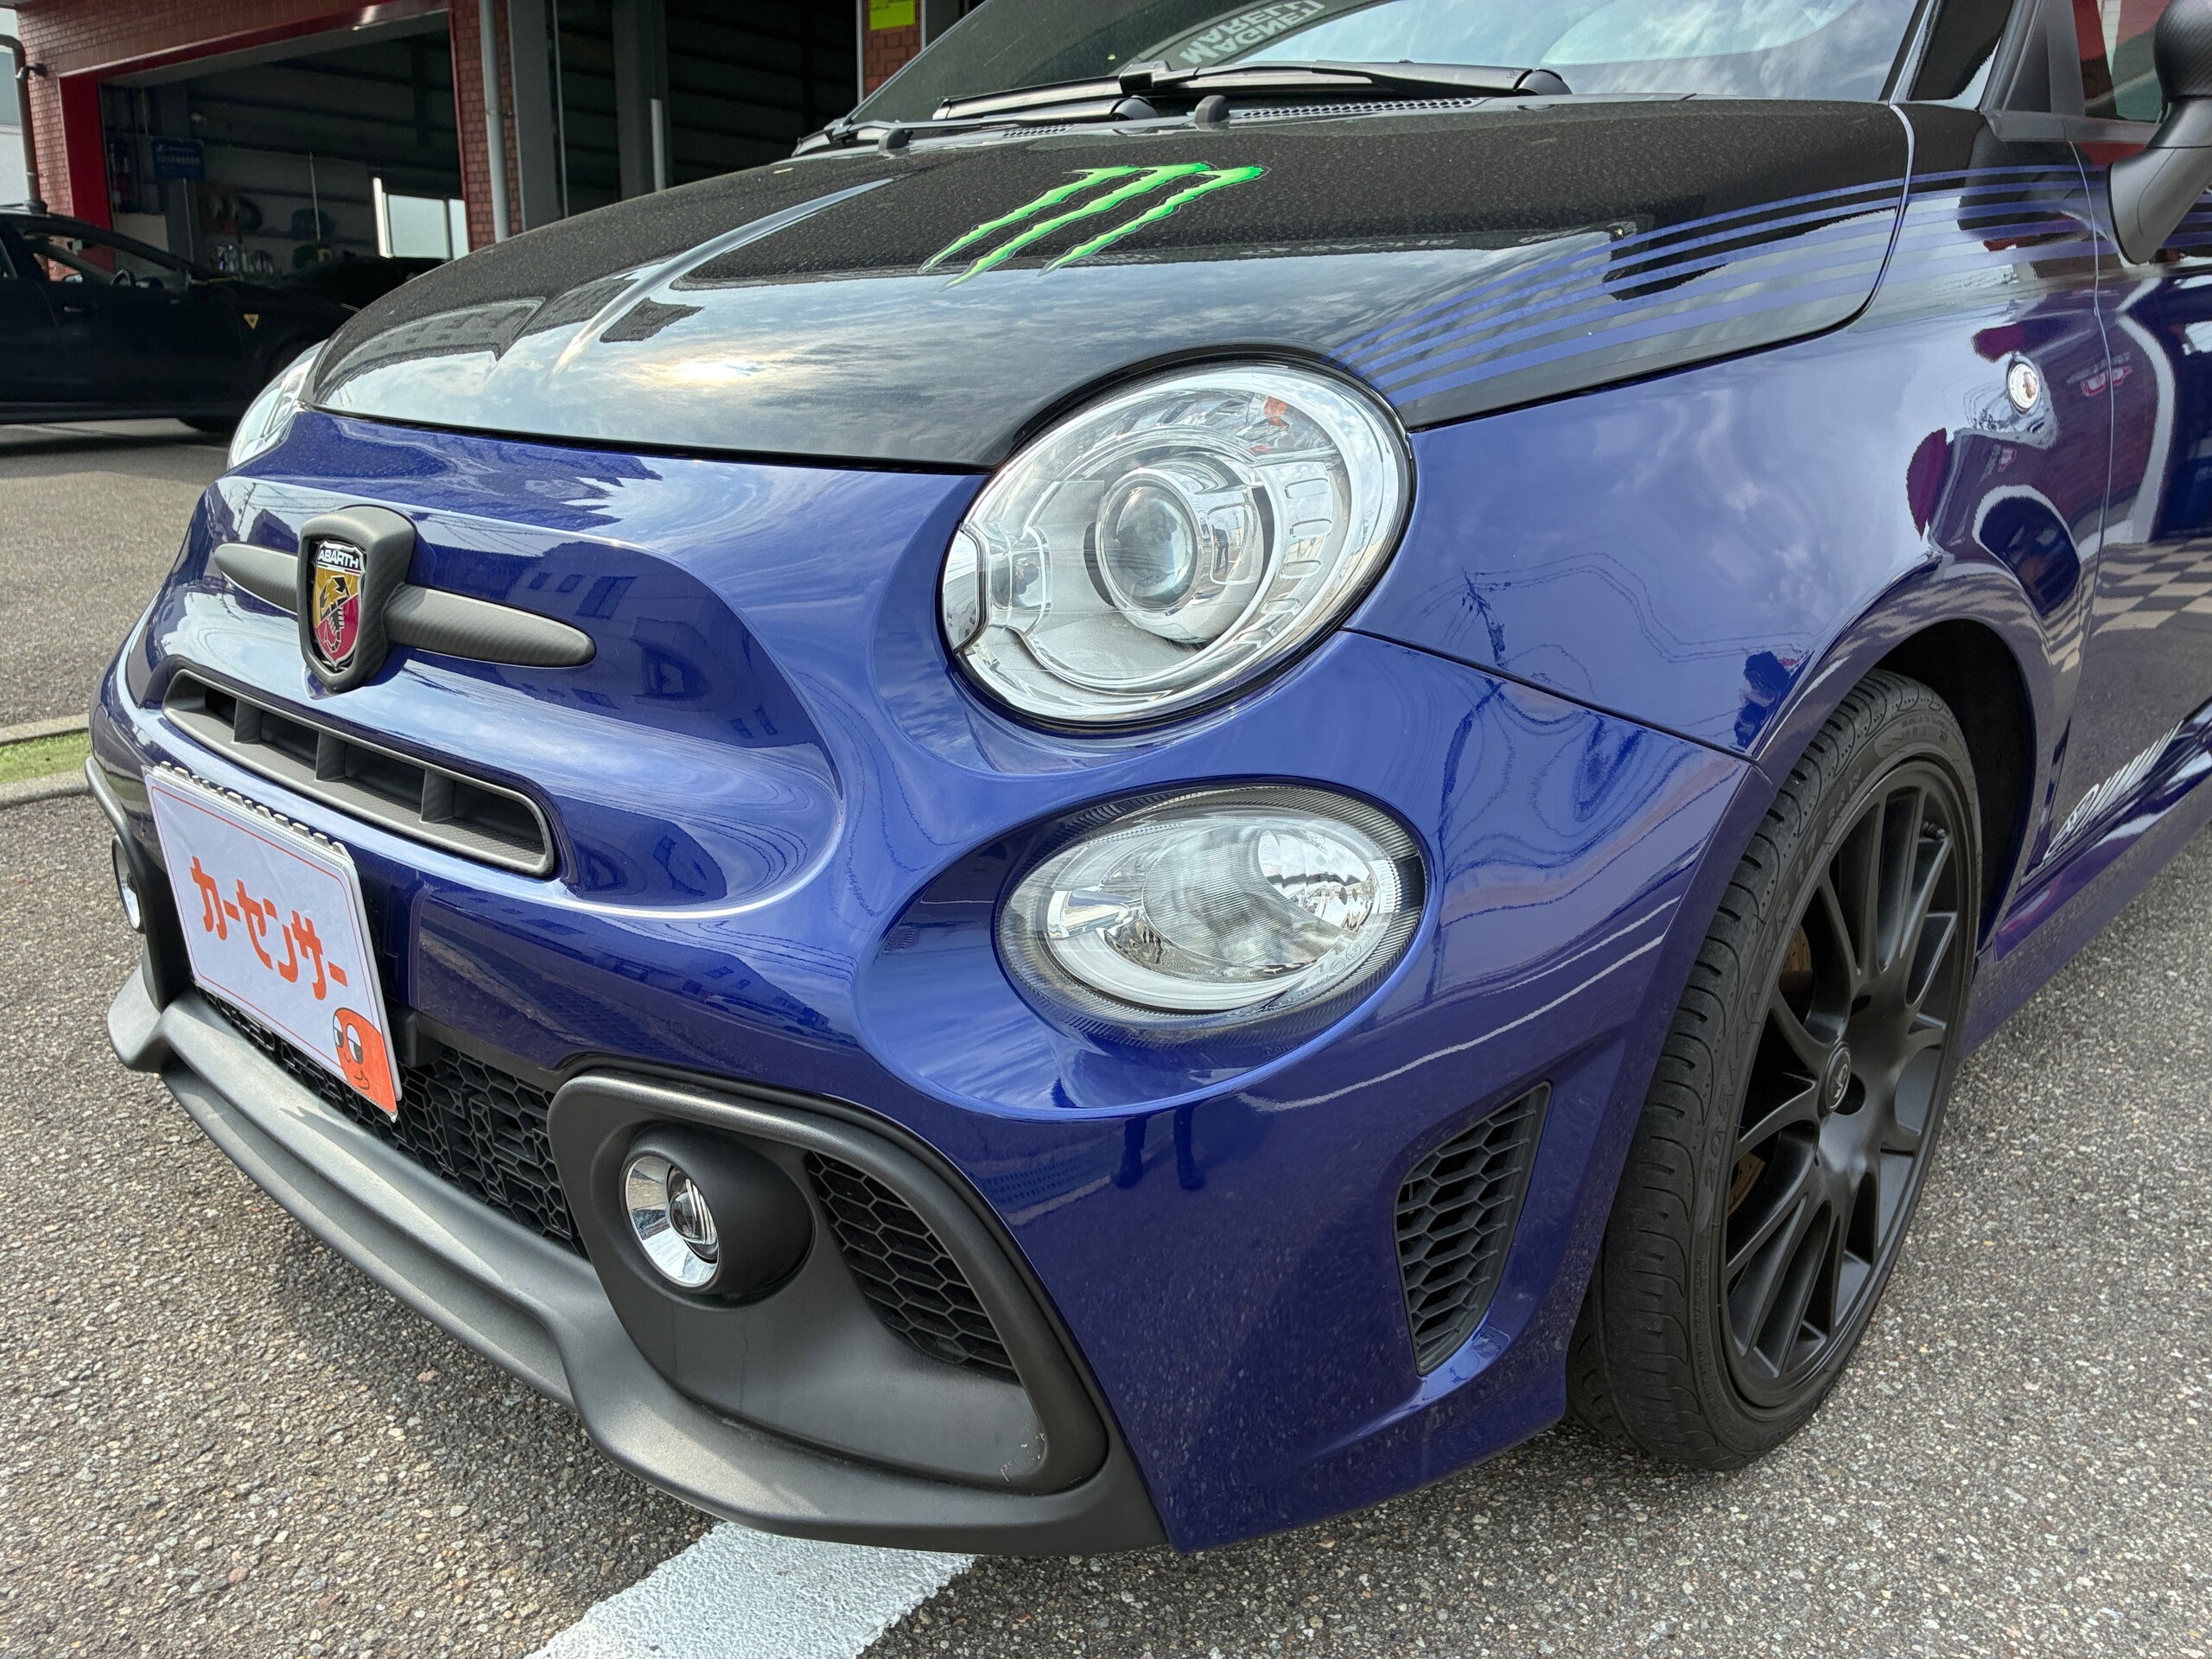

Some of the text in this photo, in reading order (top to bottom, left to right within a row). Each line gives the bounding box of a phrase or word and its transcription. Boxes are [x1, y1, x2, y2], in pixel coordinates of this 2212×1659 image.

[319, 549, 359, 569] ABARTH
[190, 855, 348, 1001] カーセンサー
